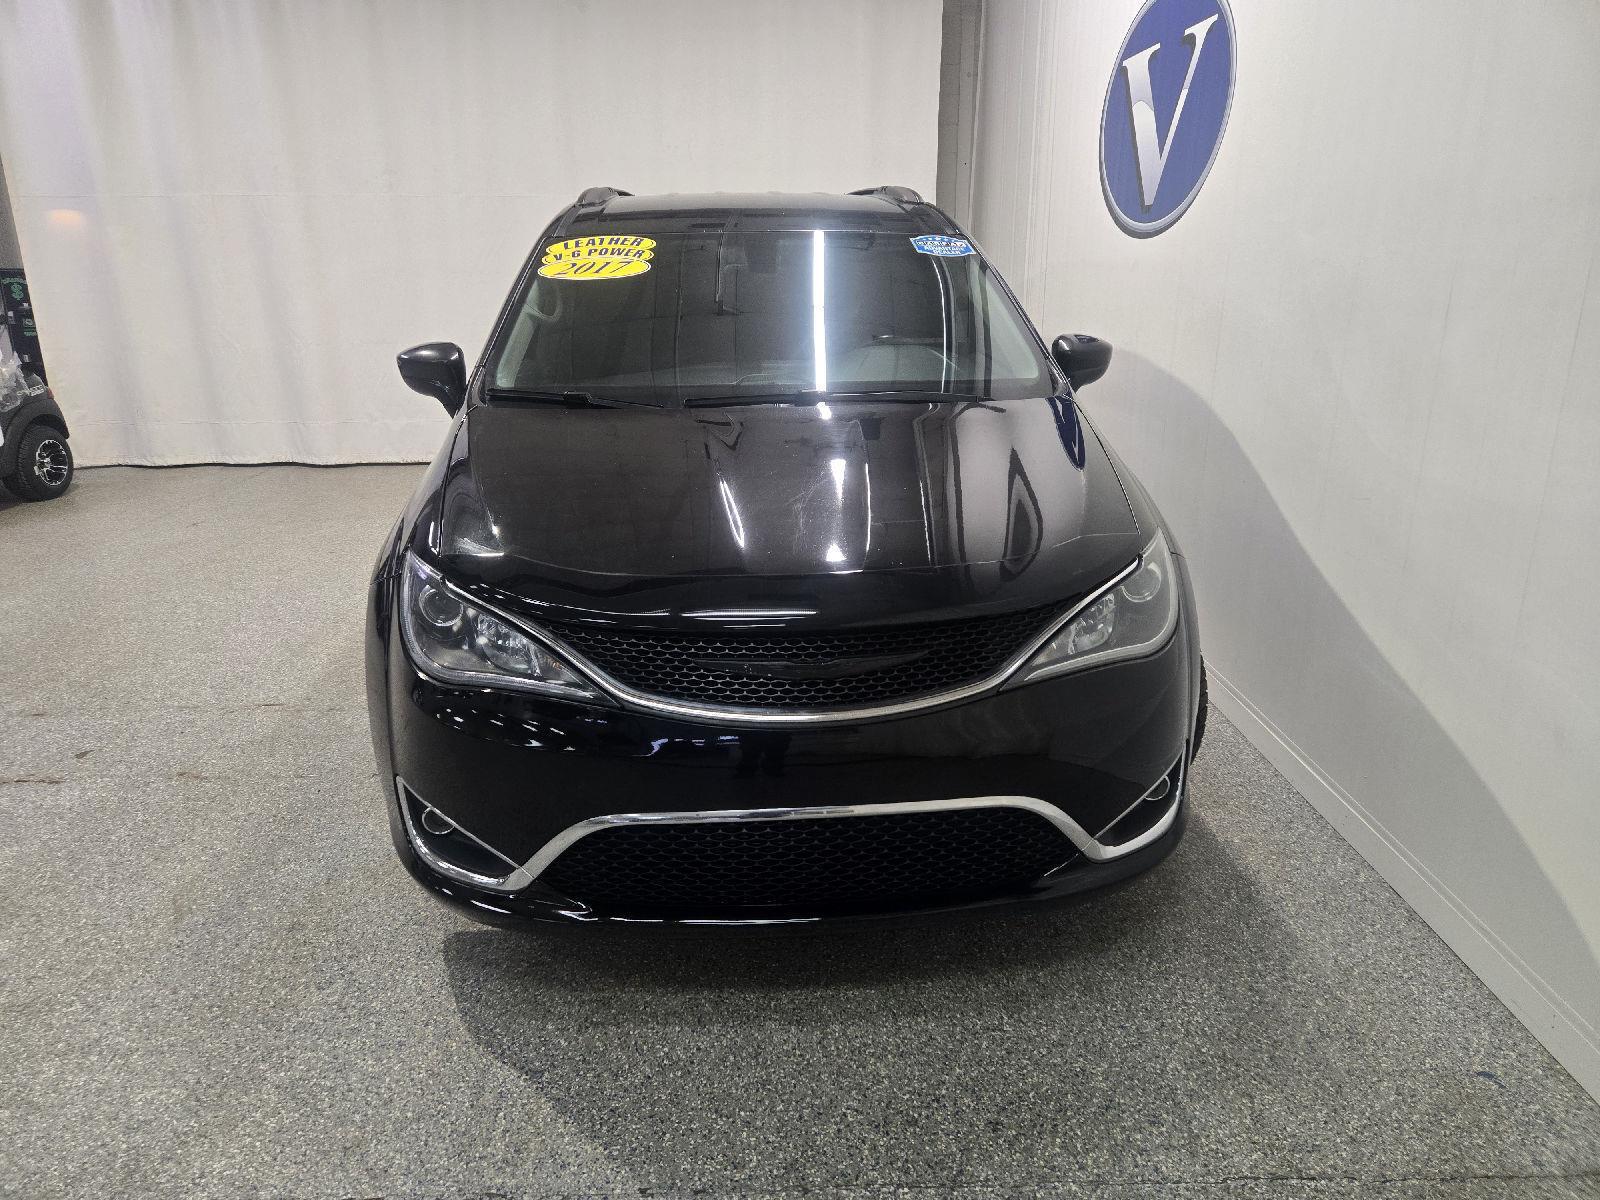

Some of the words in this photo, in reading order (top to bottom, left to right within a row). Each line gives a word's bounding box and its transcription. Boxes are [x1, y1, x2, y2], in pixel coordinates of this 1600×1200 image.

[1123, 13, 1219, 206] V
[563, 237, 645, 250] LEATHER
[587, 247, 645, 259] POWER
[553, 260, 634, 275] 2017
